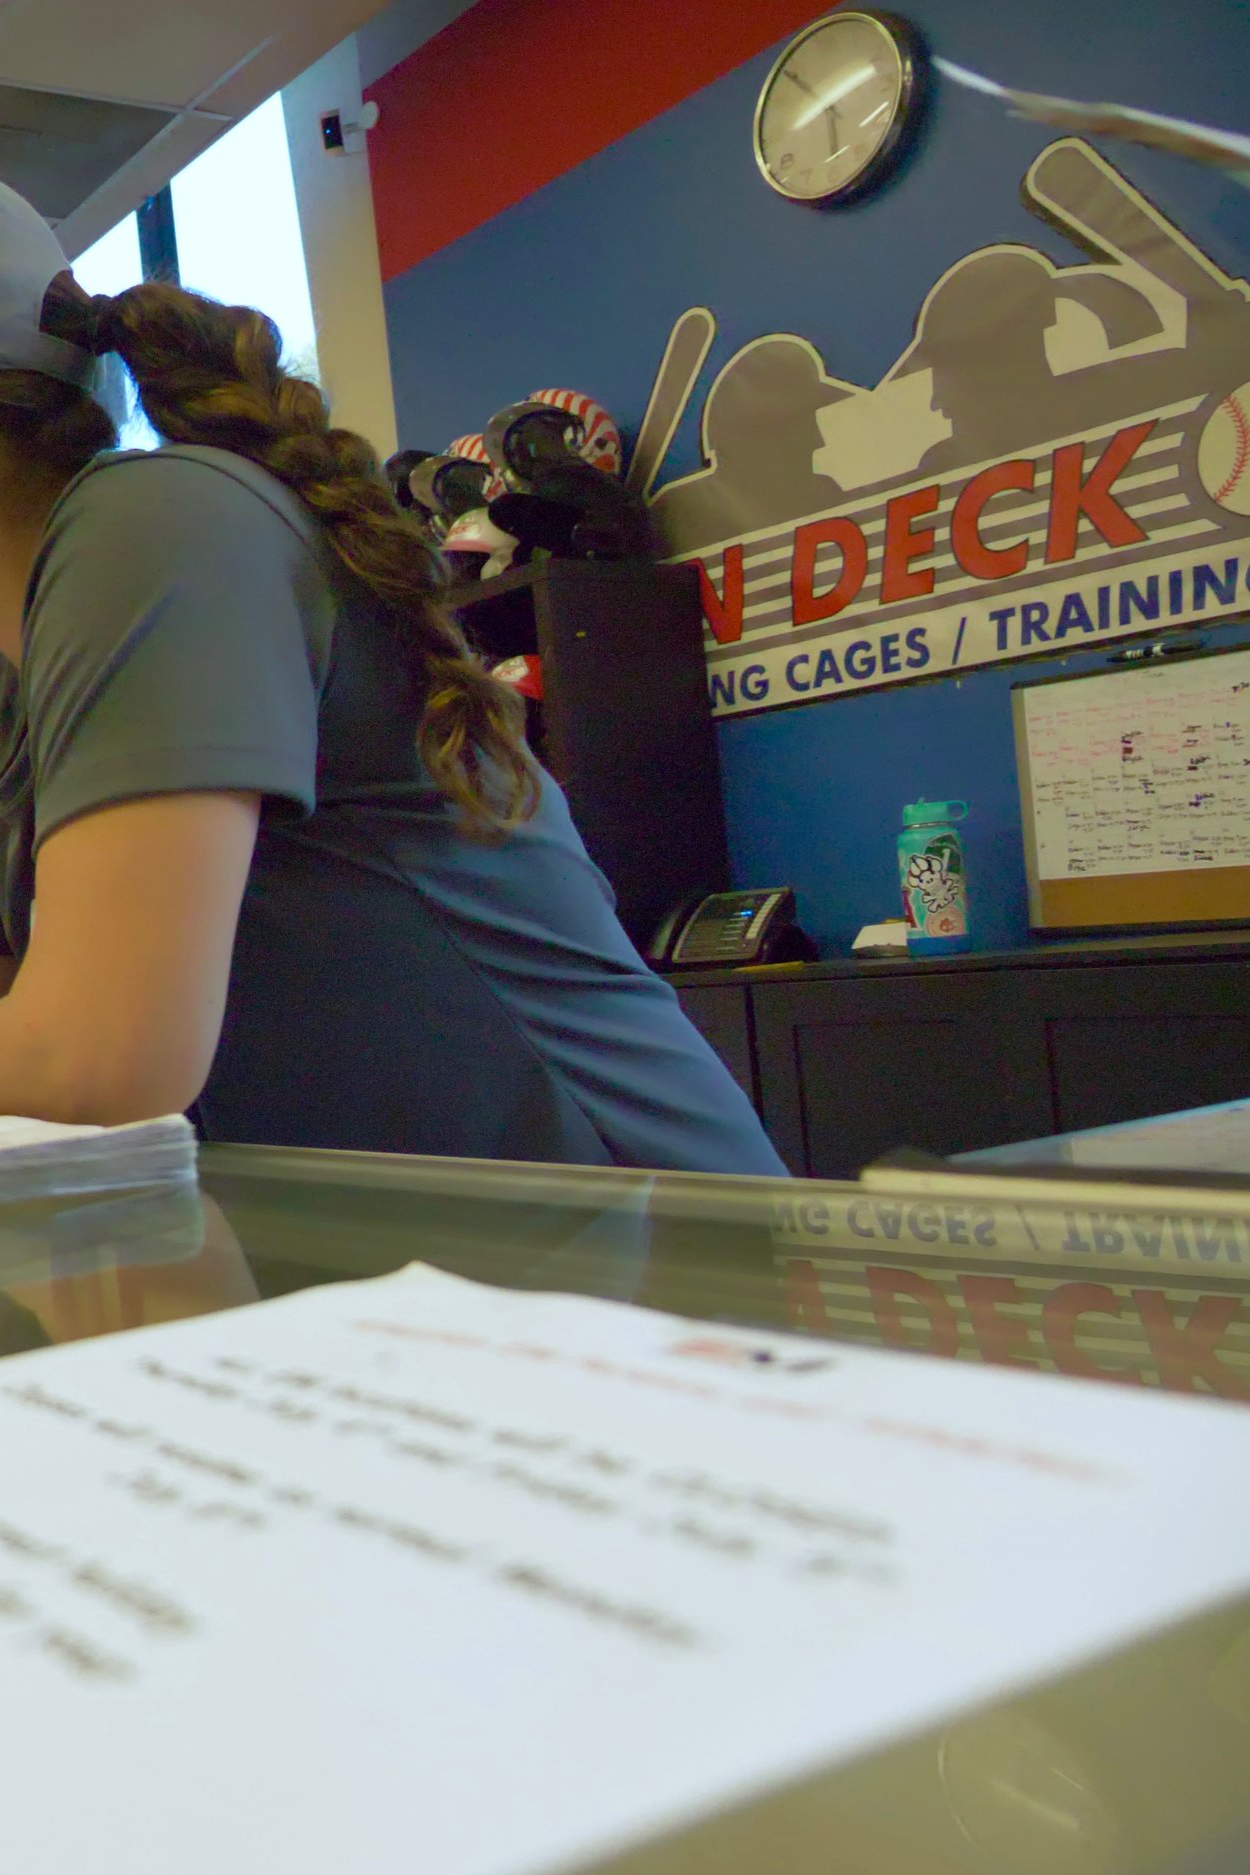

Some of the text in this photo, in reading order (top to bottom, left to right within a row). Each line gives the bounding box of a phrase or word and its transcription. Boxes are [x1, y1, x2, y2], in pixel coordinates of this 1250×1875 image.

[791, 418, 1159, 627] DECK
[785, 627, 931, 693] CAGES
[989, 557, 1250, 651] TRAININ
